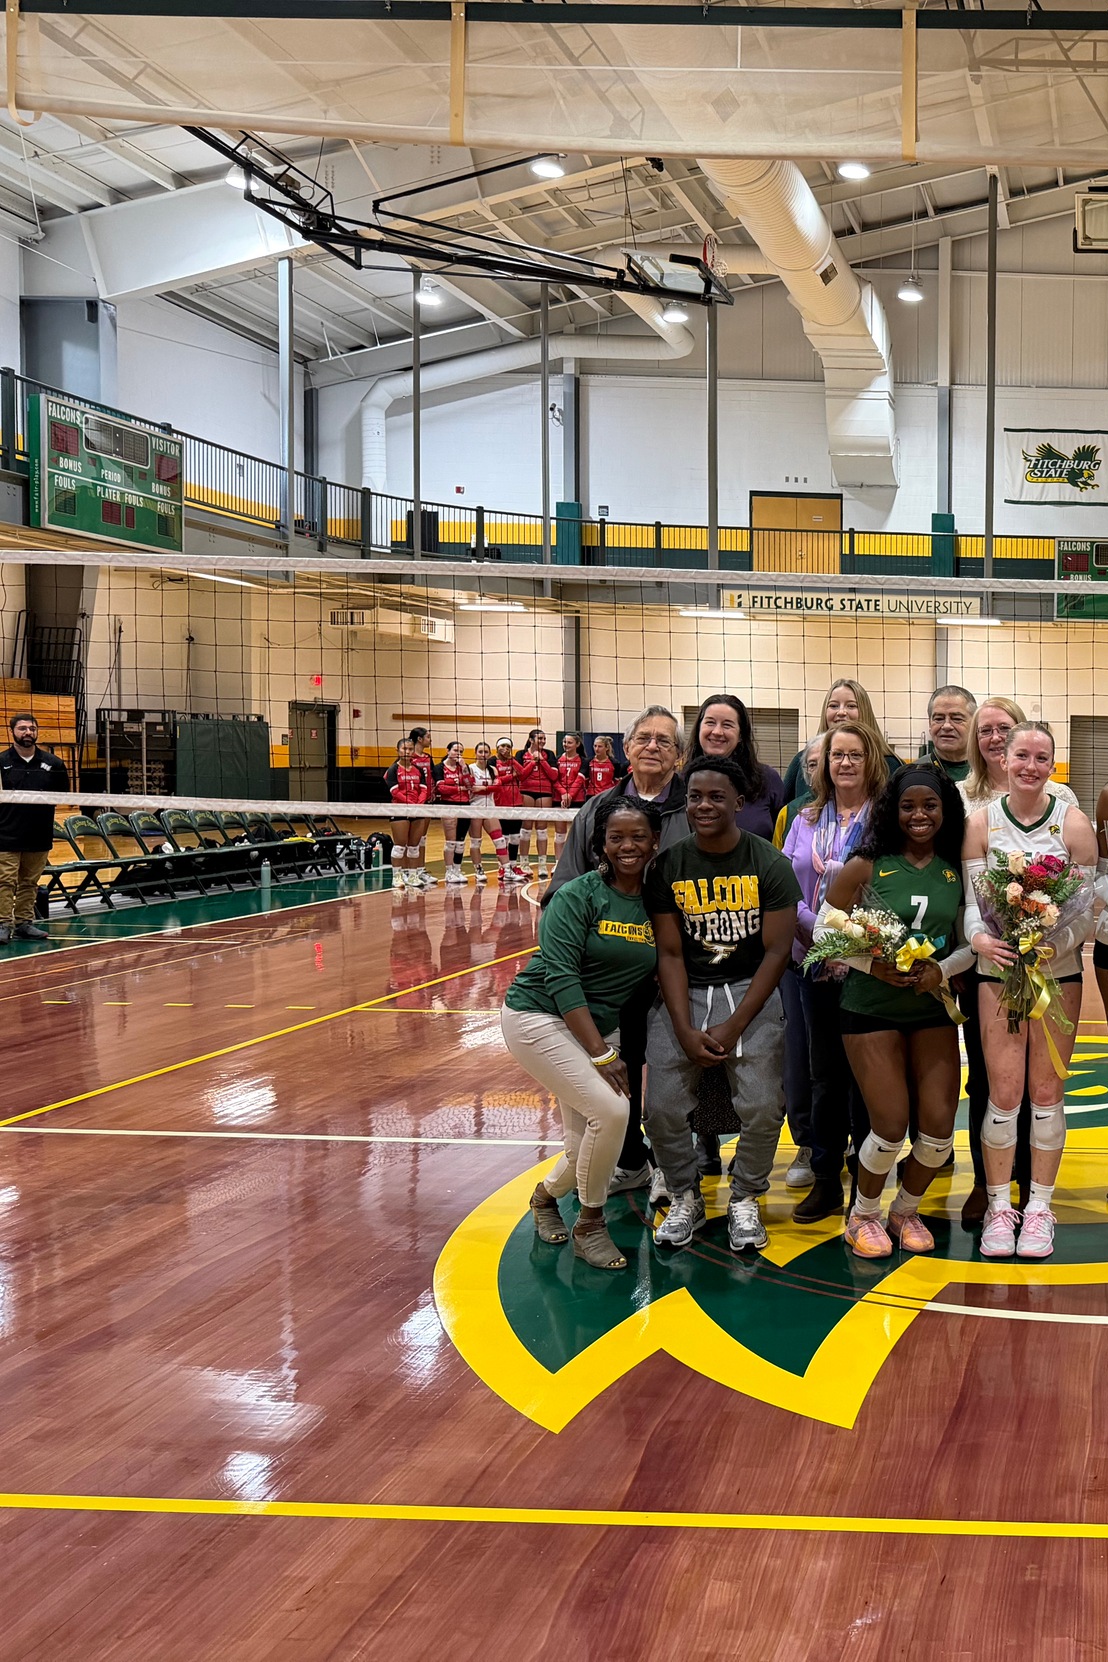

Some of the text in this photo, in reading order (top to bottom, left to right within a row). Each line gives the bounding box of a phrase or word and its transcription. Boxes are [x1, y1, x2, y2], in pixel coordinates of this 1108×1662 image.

[48, 401, 82, 425] FALCONS
[151, 436, 180, 457] VISITOR
[59, 456, 82, 473] BONUS
[1028, 457, 1101, 470] FITCHBURG
[101, 468, 121, 483] PERIOD
[1030, 468, 1071, 478] STATE
[54, 474, 76, 491] FOULS
[151, 482, 172, 497] BONUS
[96, 485, 144, 507] PLAYER FOULS
[157, 501, 176, 515] FOULS
[1060, 541, 1091, 552] FALCONS
[751, 595, 973, 614] FITCHBURG STATE UNIVERSITY
[596, 772, 603, 781] 8
[671, 875, 760, 915] FALCON
[910, 895, 929, 930] 7
